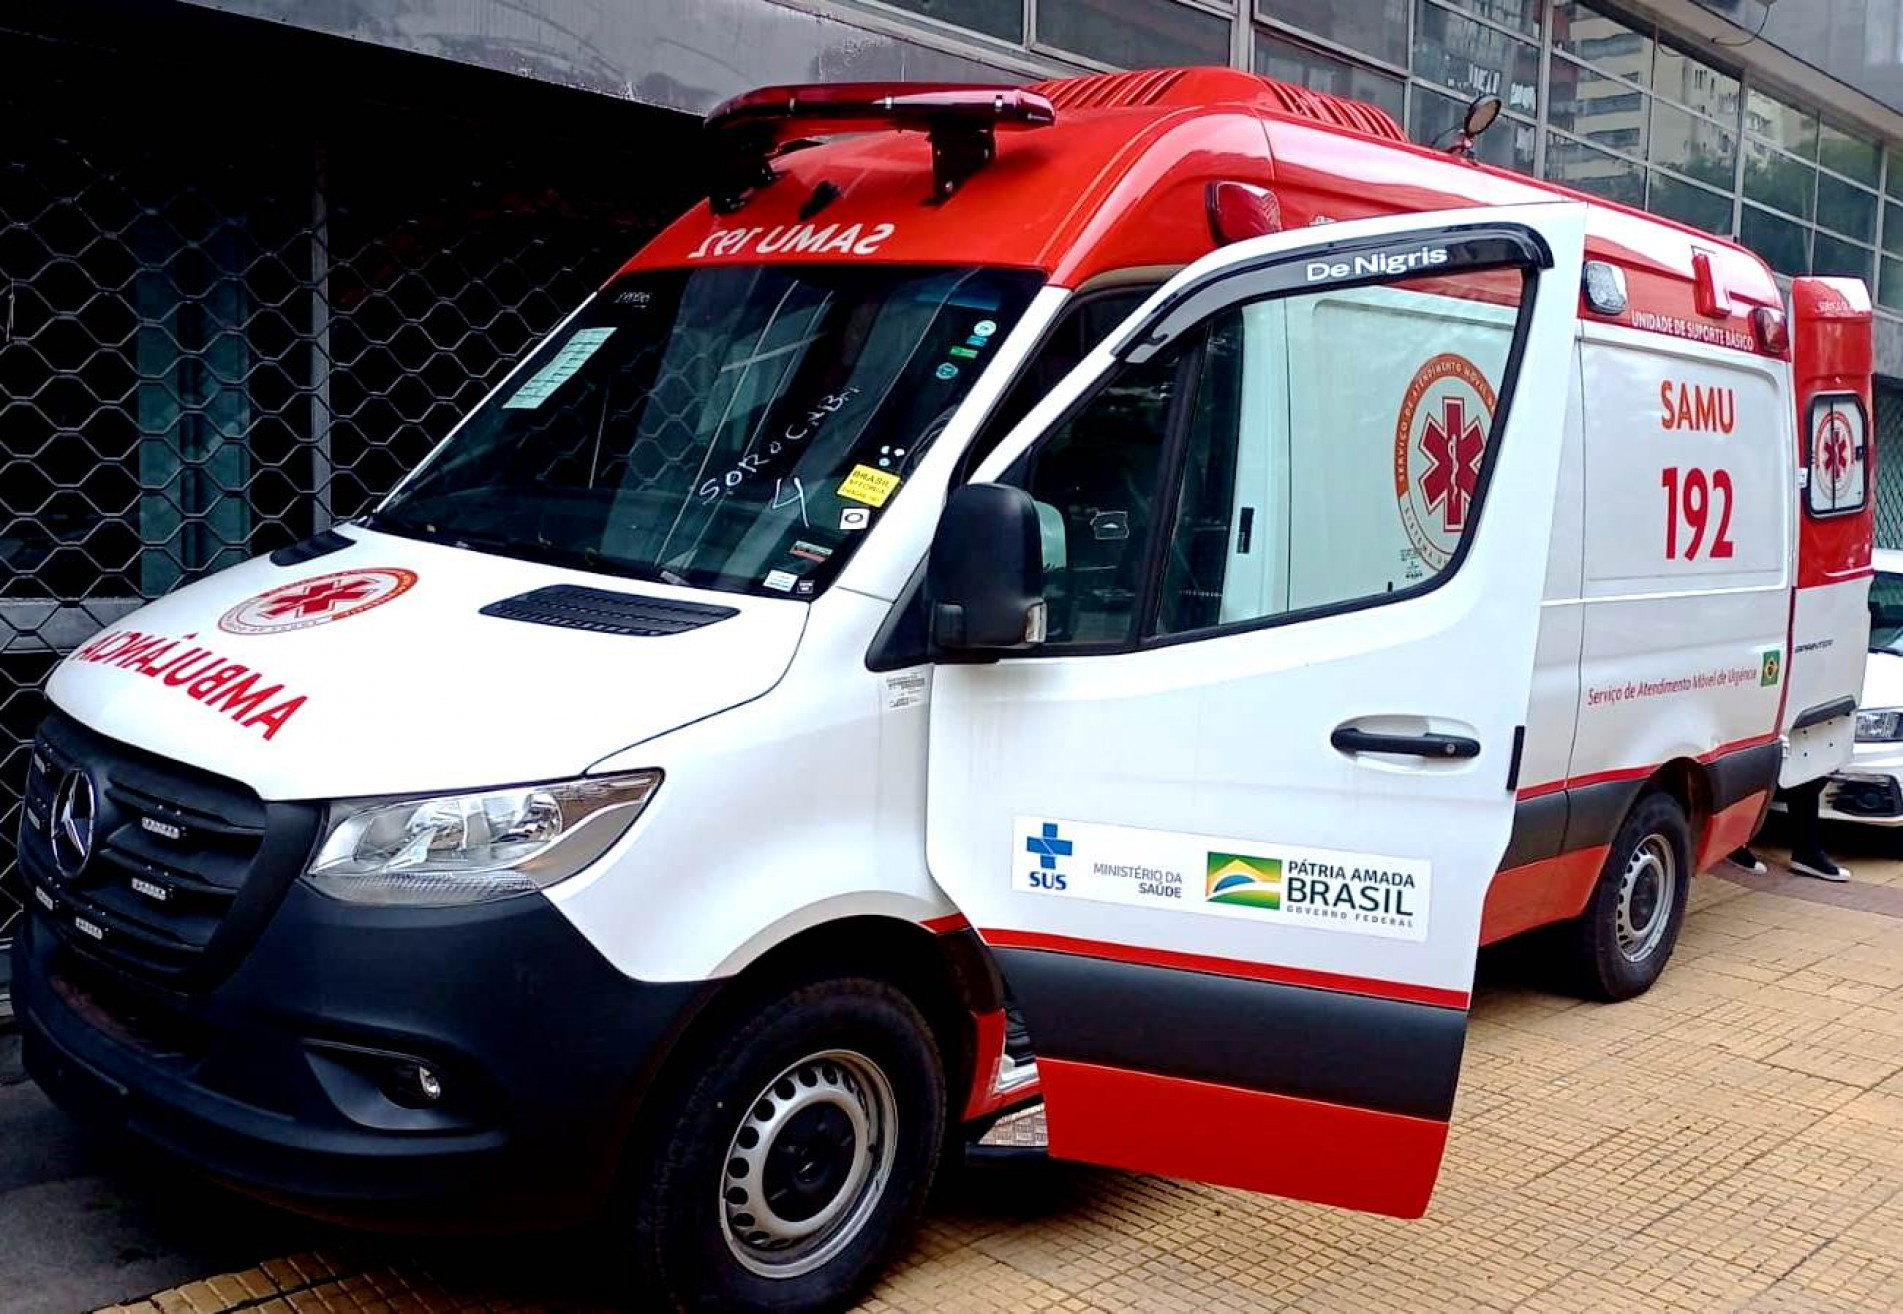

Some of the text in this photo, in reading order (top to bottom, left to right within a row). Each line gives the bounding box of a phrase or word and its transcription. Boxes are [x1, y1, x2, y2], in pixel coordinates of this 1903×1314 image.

[1307, 246, 1448, 281] De Nigris
[1631, 309, 1754, 351] UNIDADE DE SUPORTE BÁSICO
[1661, 379, 1734, 434] SAMU
[1661, 467, 1733, 561] 192
[1588, 687, 1622, 705] Serviço
[1624, 681, 1636, 700] de
[1637, 677, 1692, 697] Atendimento
[1693, 671, 1716, 690] Móvel
[1717, 670, 1727, 685] de
[1029, 870, 1067, 891] SUS
[1093, 861, 1182, 884] MINISTÉRIO DA
[1138, 880, 1182, 899] SAÚDE
[1288, 858, 1415, 888] PÁTRIA AMADA
[1287, 876, 1413, 917] BRASIL
[1286, 904, 1413, 928] GOVERNO FEDERAL
